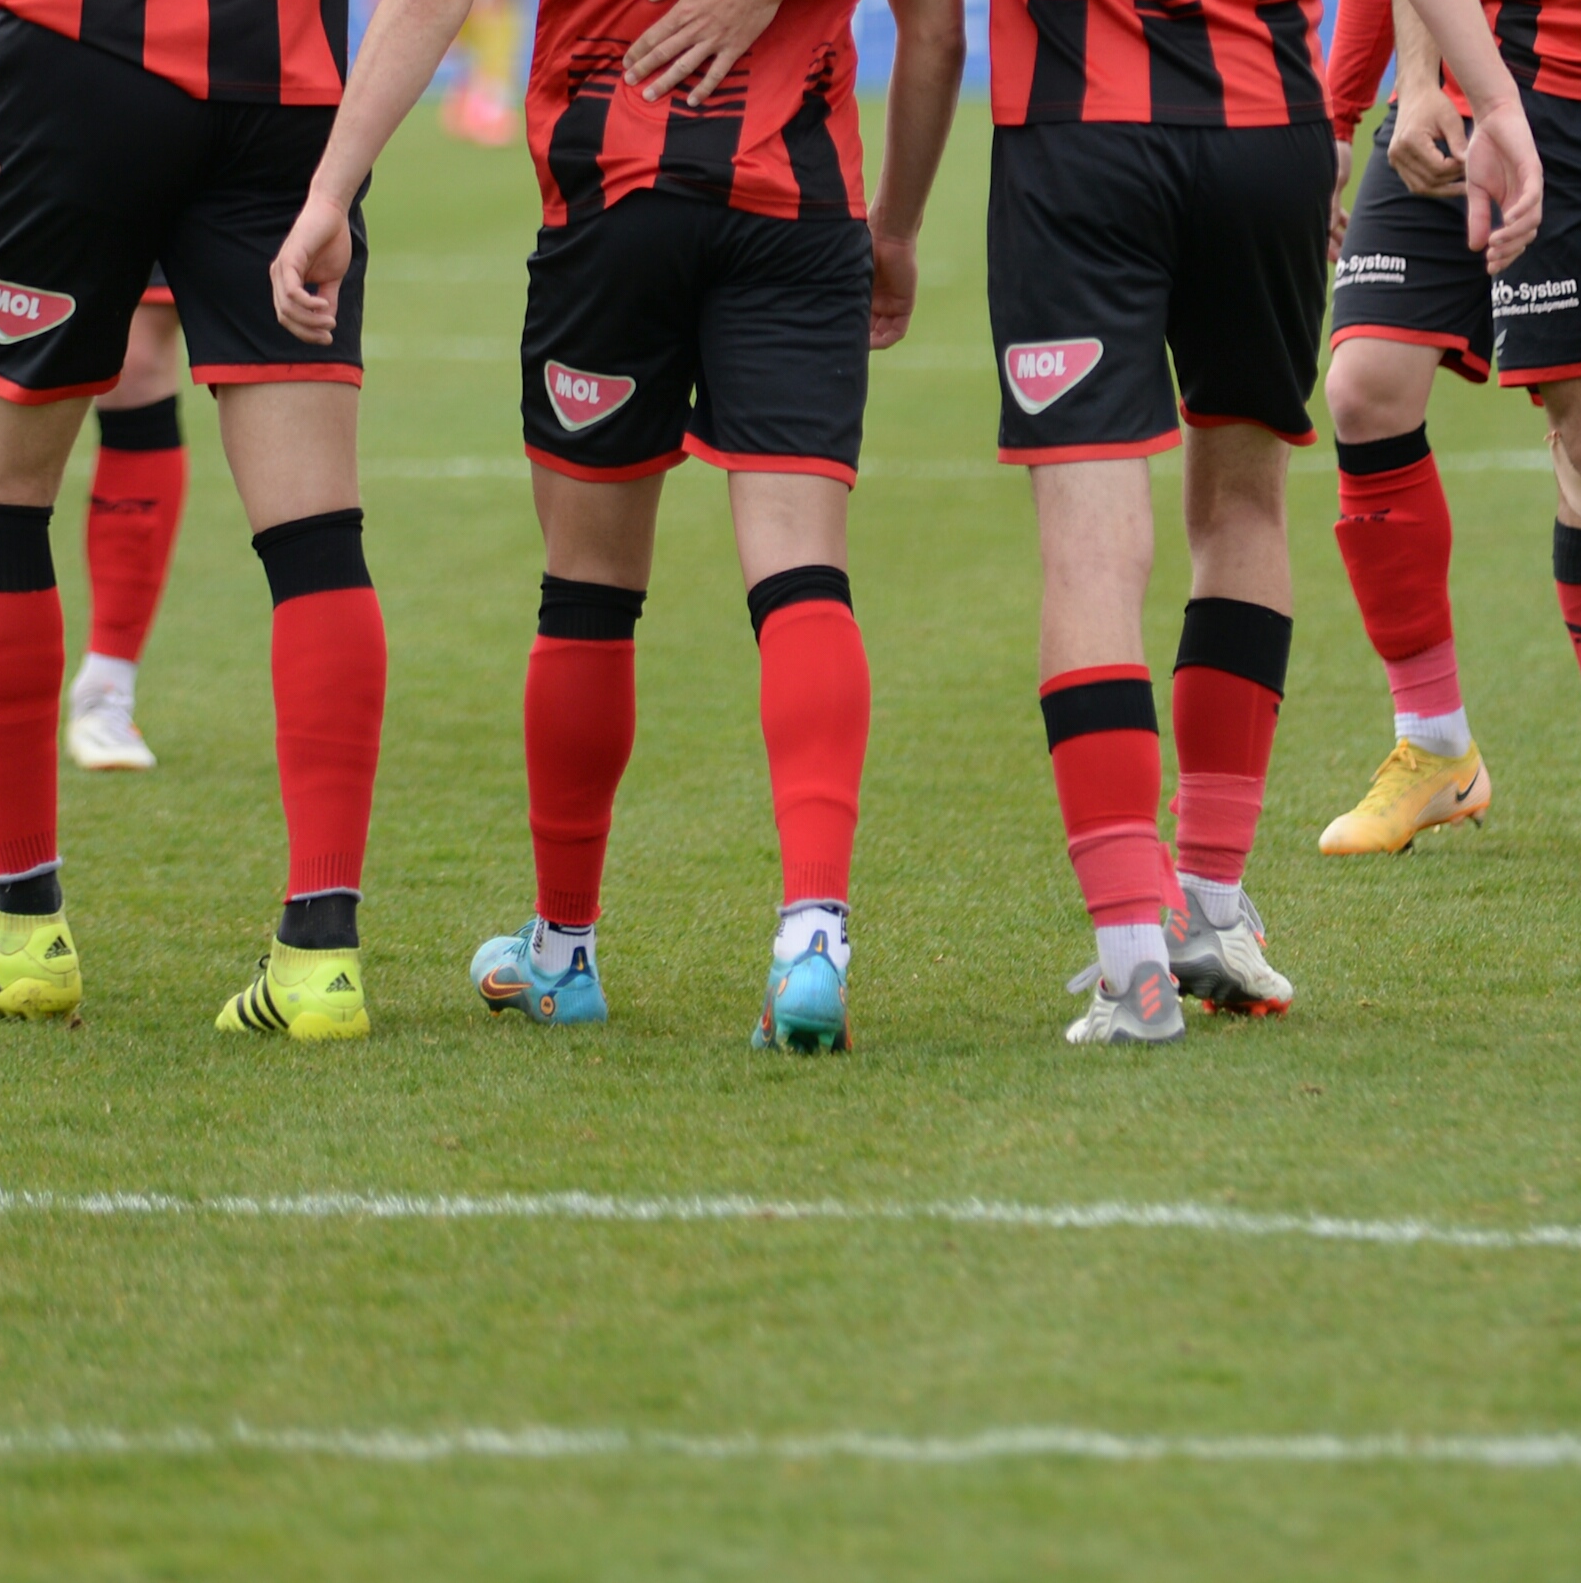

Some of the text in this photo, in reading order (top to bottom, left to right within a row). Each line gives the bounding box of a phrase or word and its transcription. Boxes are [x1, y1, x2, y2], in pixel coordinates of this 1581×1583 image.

[1336, 252, 1407, 279] b-System
[1017, 350, 1067, 379] MOL
[555, 372, 601, 405] MOL
